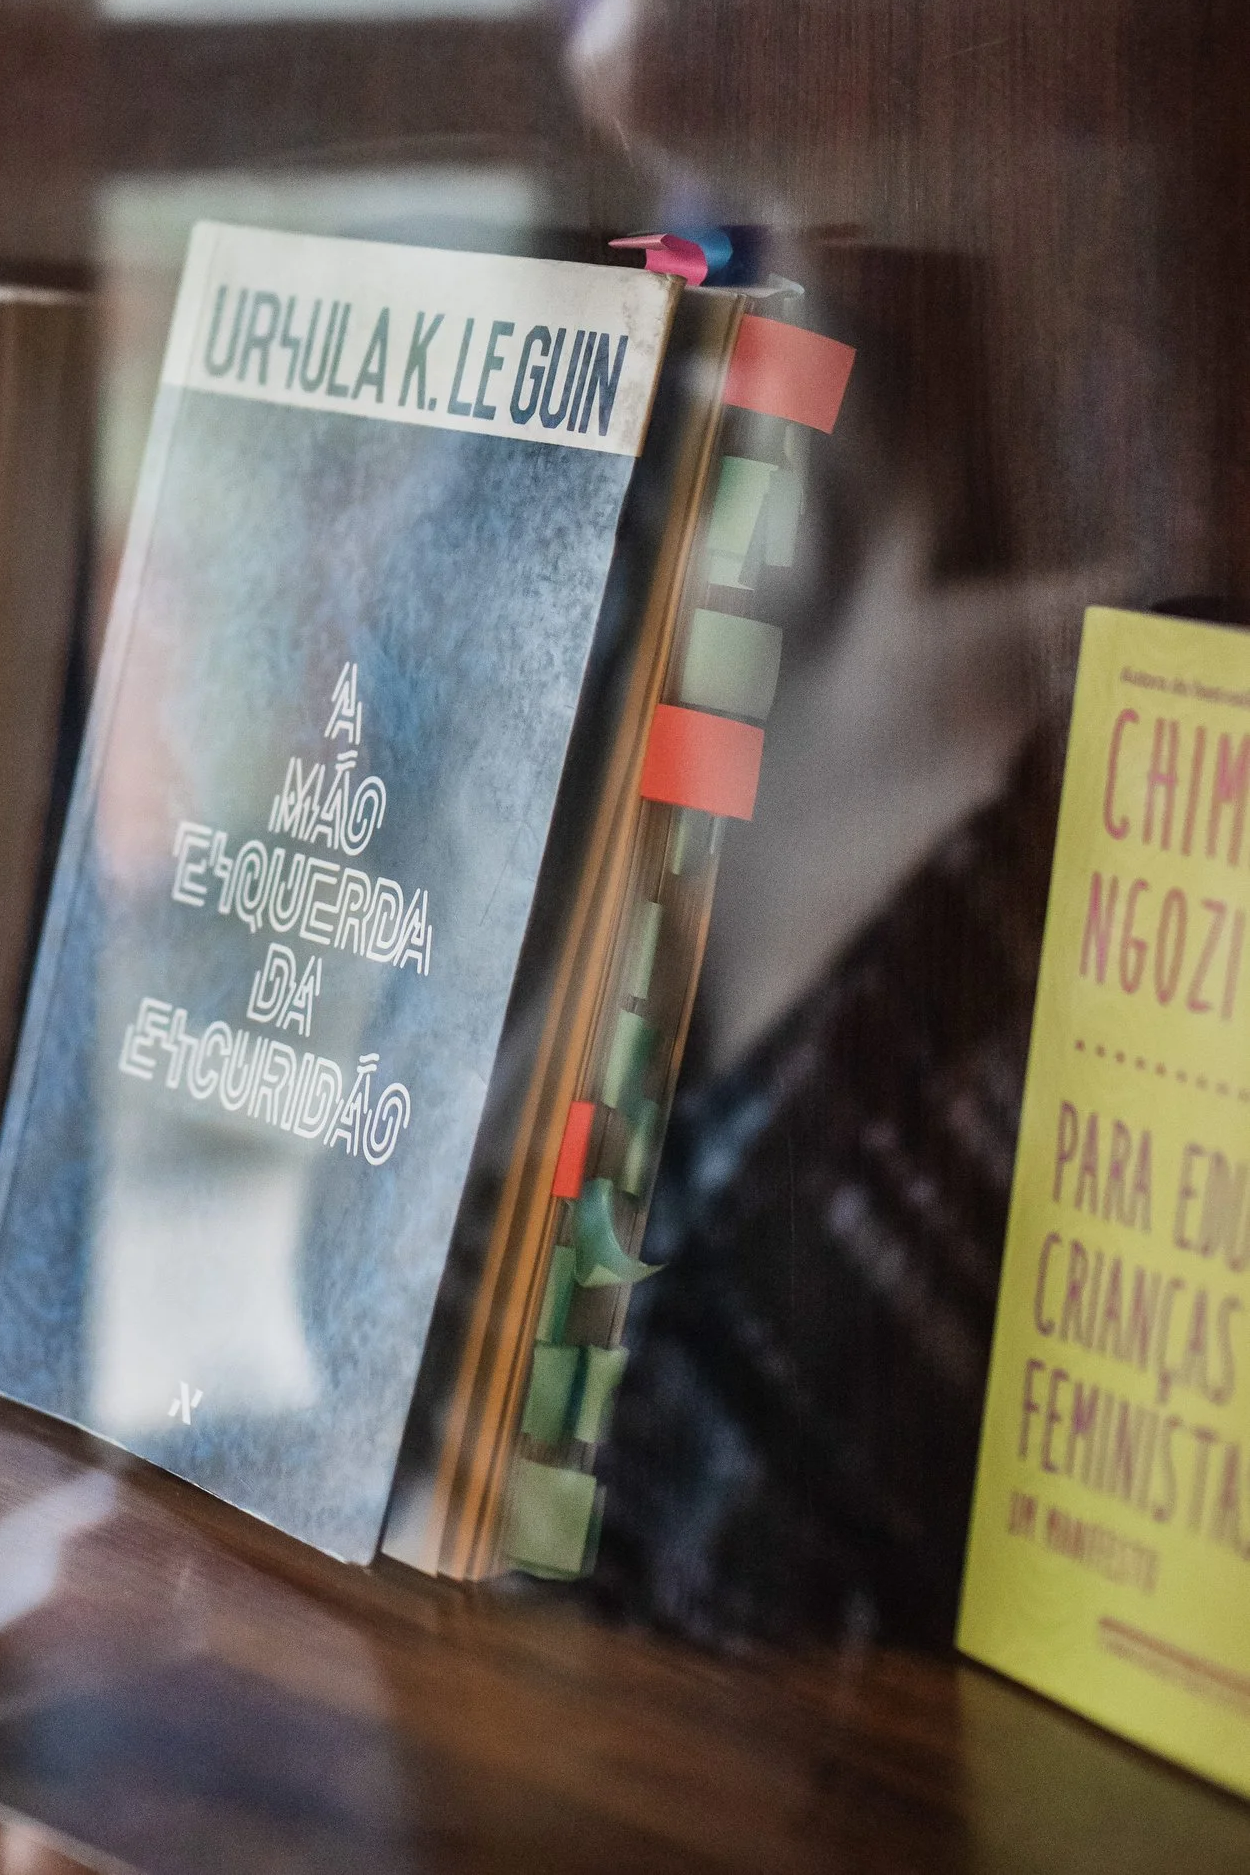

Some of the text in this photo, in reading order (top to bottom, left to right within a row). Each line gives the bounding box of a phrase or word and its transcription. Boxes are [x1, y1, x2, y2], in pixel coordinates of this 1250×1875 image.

[202, 285, 629, 437] URSULA K. LE GUIN
[325, 661, 363, 745] A
[268, 749, 388, 857] MÃO
[246, 942, 322, 1038] DA
[1080, 870, 1248, 1022] NGOZI
[1052, 1099, 1153, 1235] PARA
[1033, 1231, 1244, 1407] CRIANÇAS
